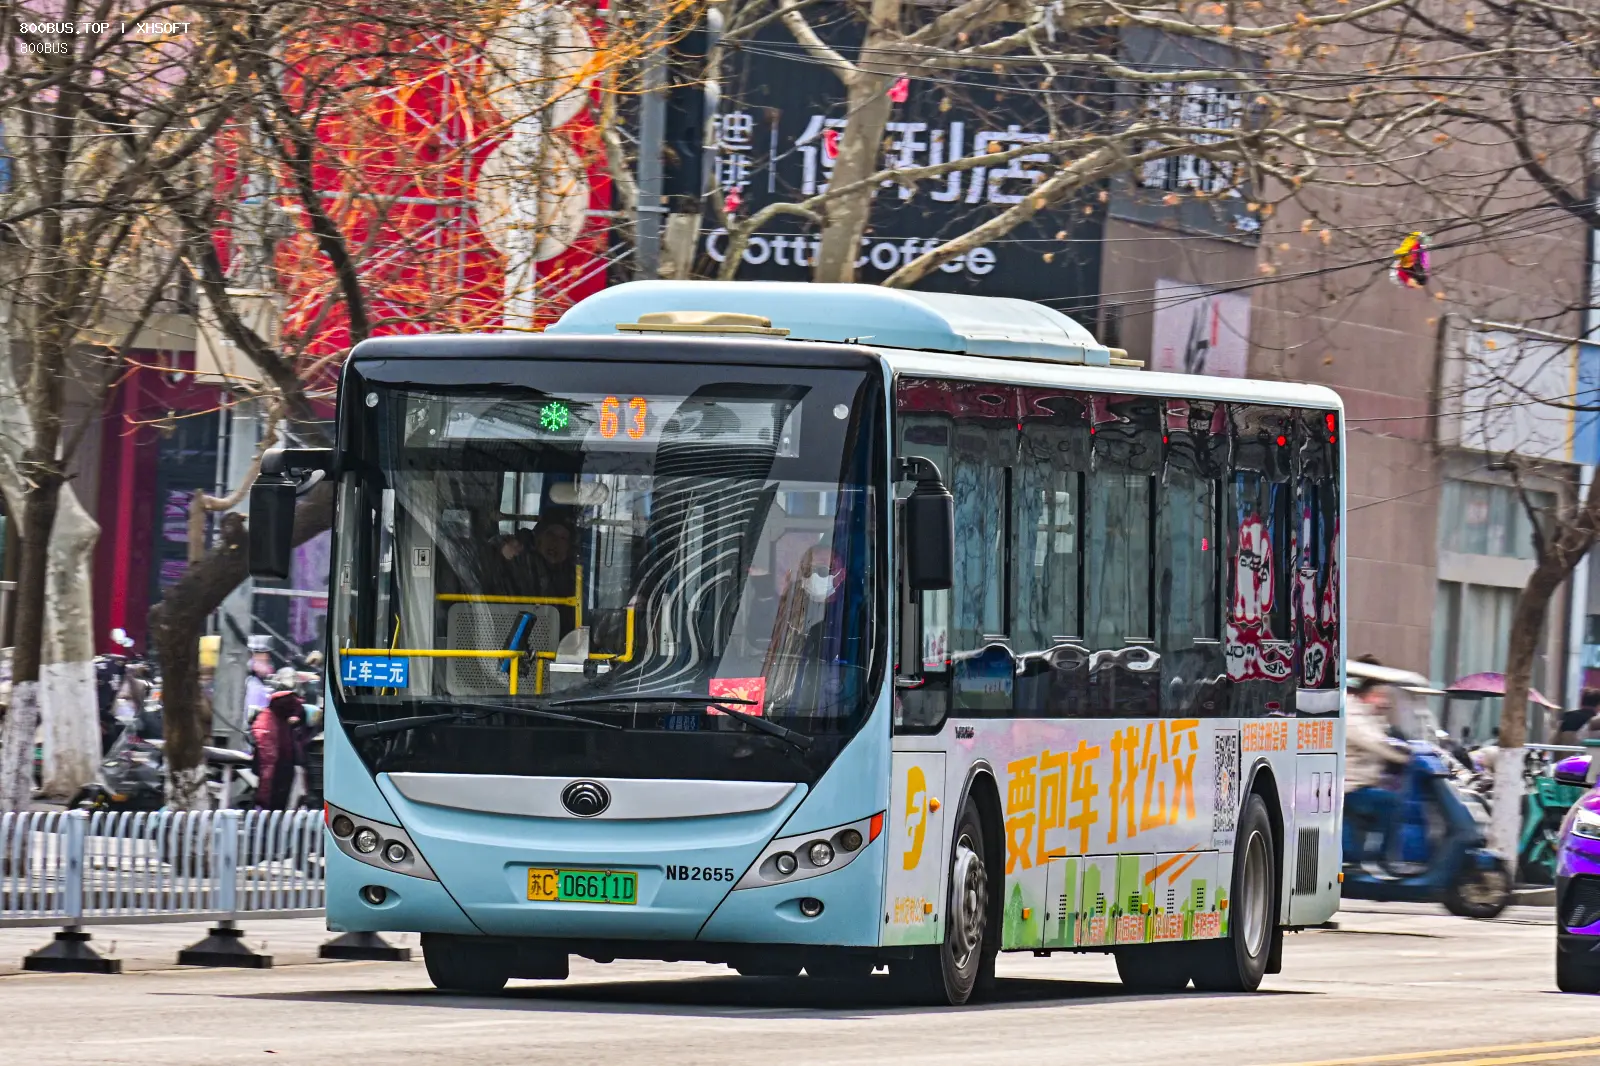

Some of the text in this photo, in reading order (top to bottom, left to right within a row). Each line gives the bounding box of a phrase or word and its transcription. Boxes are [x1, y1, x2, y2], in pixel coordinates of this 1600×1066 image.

[600, 396, 647, 439] 63
[343, 660, 404, 683] 上车二元
[1005, 719, 1200, 875] 要包车 找公交
[666, 865, 735, 882] NB2655
